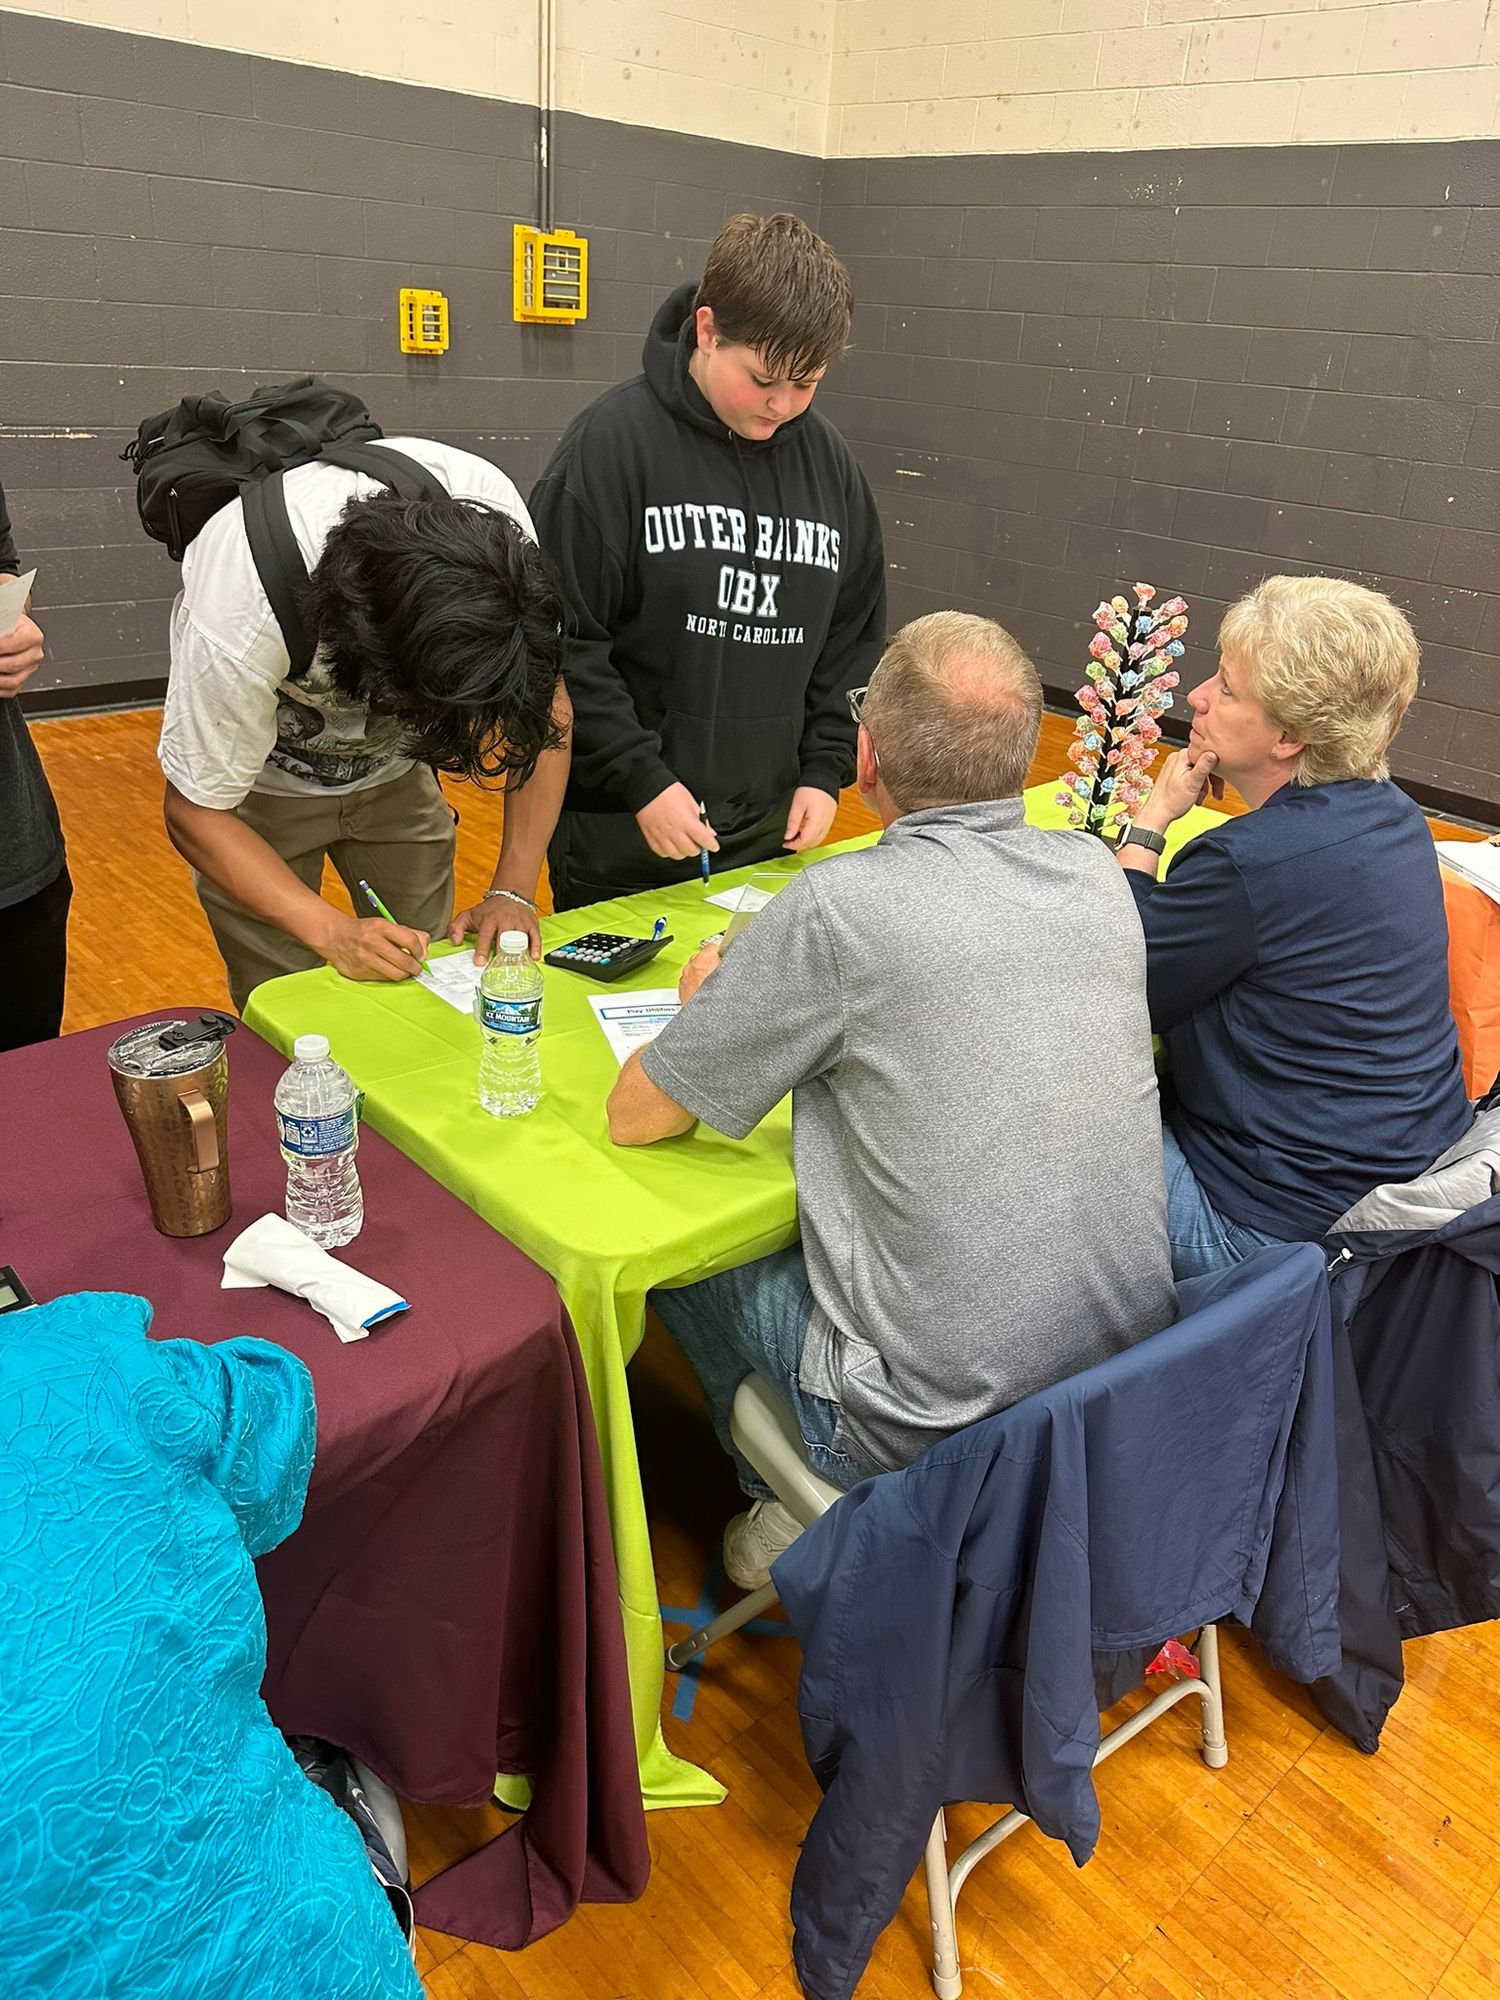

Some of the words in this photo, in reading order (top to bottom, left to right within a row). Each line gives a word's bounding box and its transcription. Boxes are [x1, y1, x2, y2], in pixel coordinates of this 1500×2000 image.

[645, 503, 746, 553] OUTER
[755, 515, 841, 573] BANKS
[717, 564, 781, 618] OBX
[733, 623, 804, 645] CAROLINA
[495, 1012, 530, 1023] MOUNTAIN
